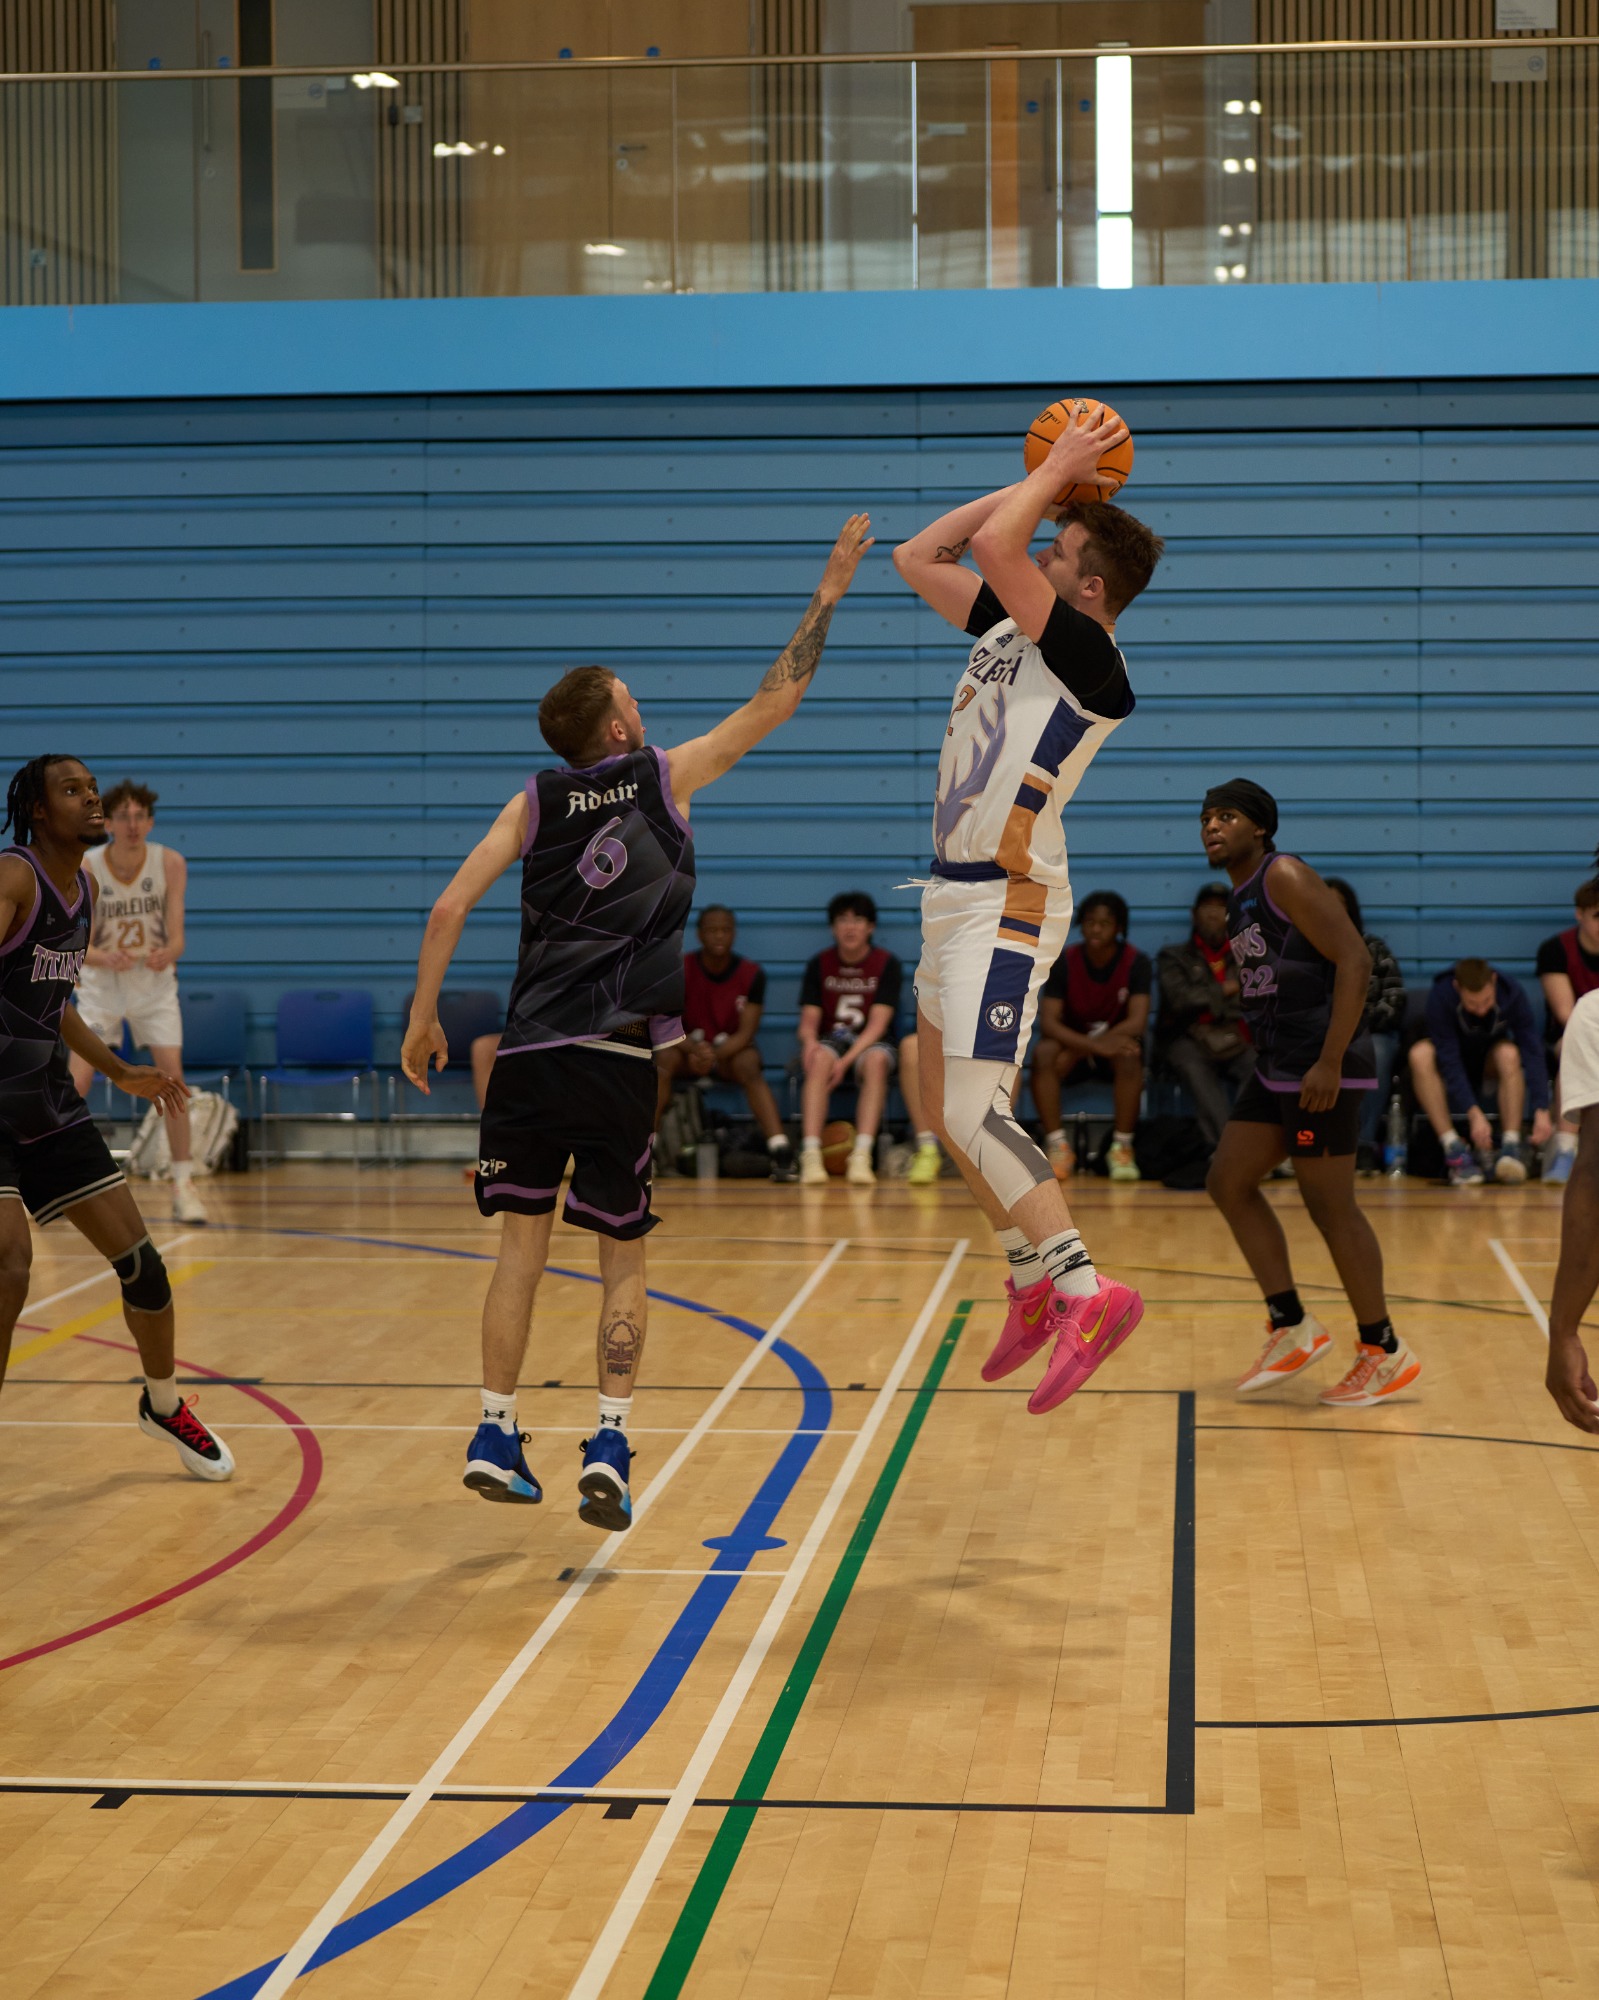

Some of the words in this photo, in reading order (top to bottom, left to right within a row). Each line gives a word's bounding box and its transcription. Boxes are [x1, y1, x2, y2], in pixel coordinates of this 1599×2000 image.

[565, 780, 639, 819] Adair
[576, 816, 628, 890] 6
[117, 919, 145, 949] 23
[1239, 964, 1279, 998] 22
[834, 993, 865, 1031] 5
